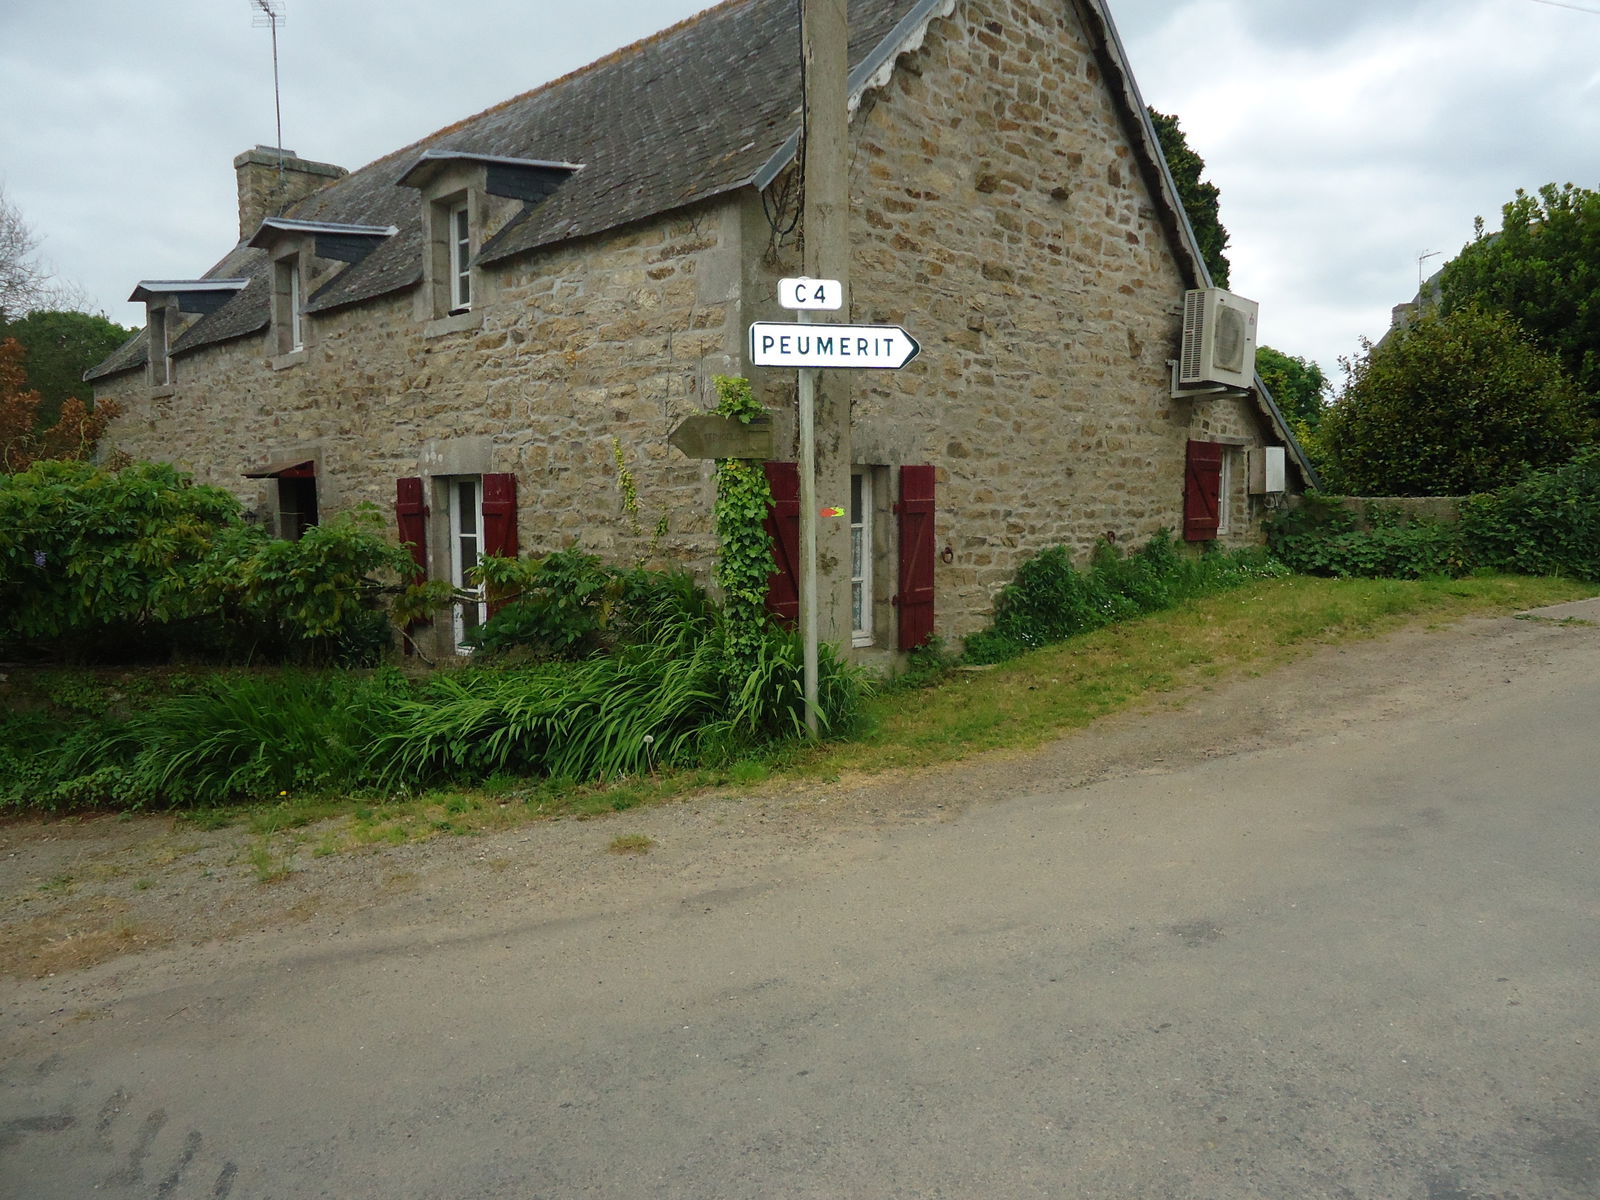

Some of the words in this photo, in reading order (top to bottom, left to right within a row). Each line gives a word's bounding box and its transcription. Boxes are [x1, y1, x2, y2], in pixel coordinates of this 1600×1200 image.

[795, 284, 807, 303] C
[813, 285, 826, 304] 4
[762, 335, 894, 357] PEUMERIT
